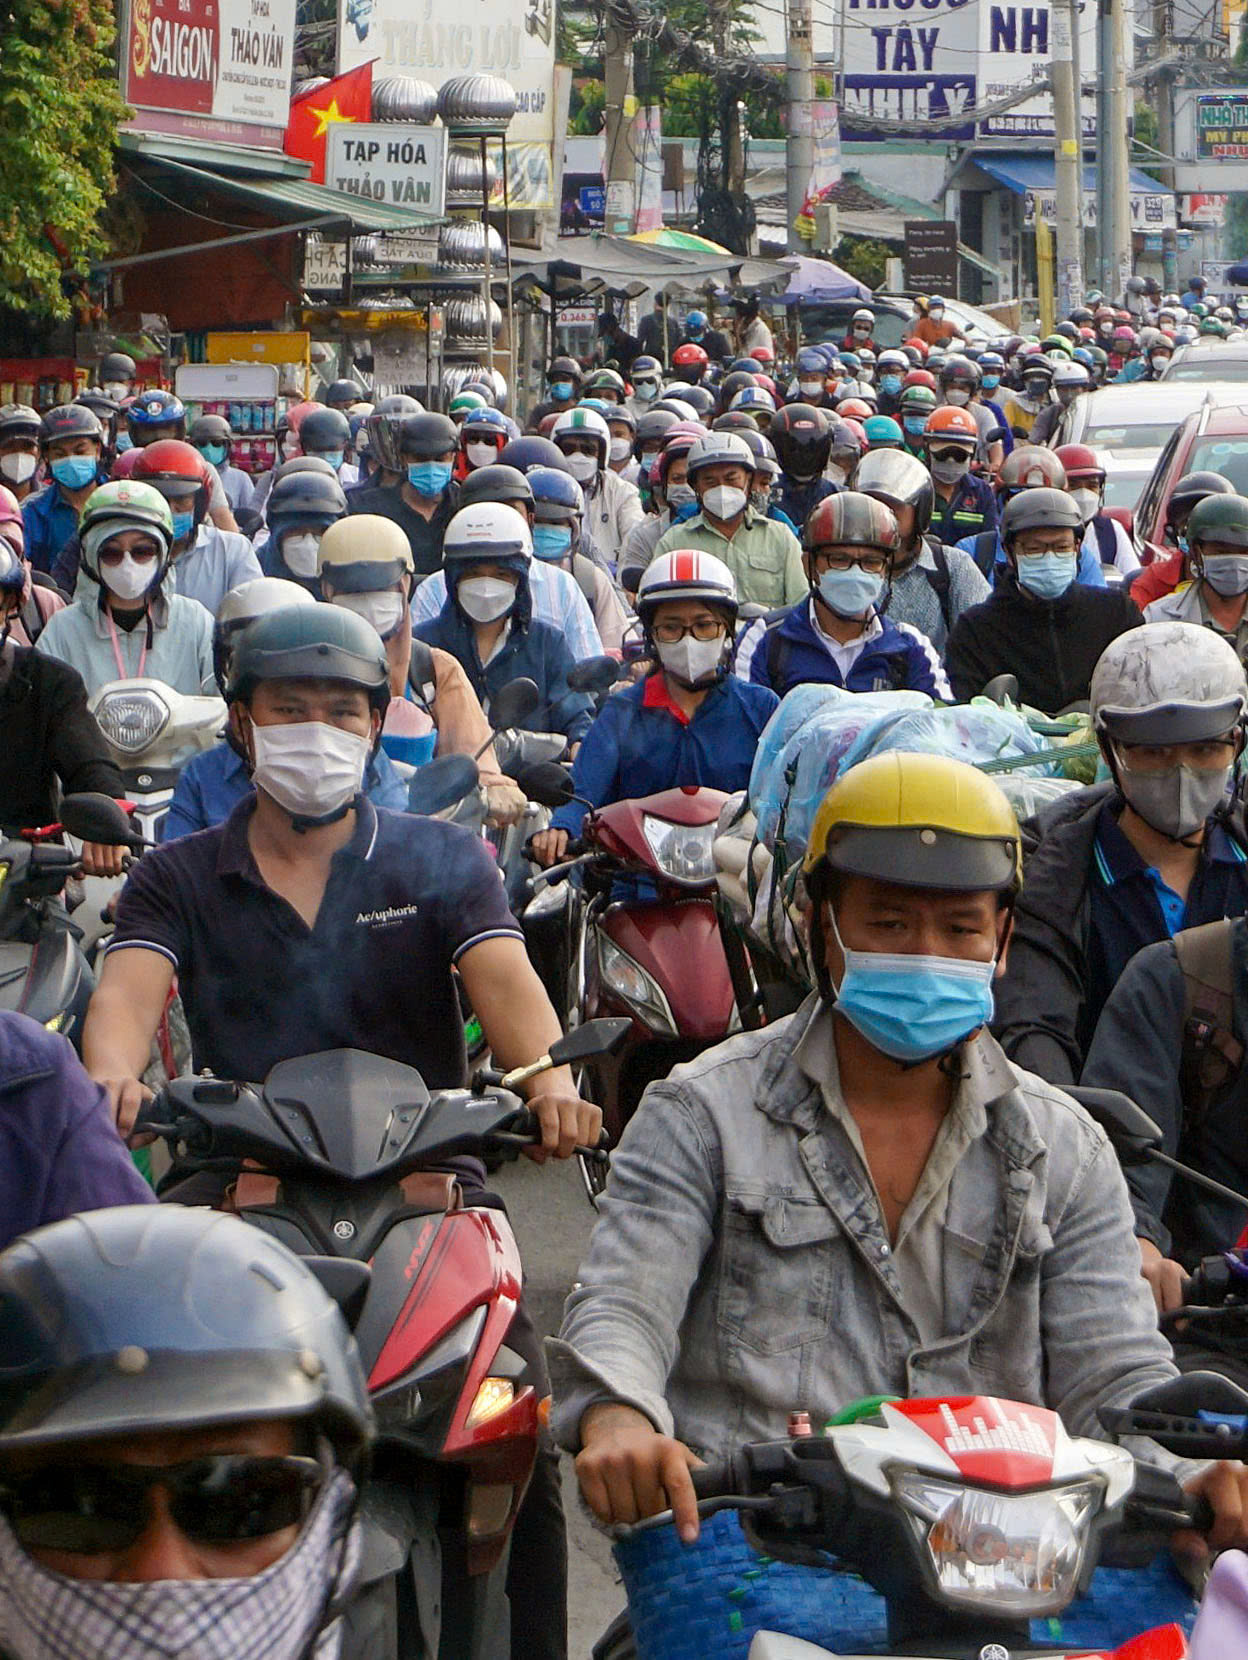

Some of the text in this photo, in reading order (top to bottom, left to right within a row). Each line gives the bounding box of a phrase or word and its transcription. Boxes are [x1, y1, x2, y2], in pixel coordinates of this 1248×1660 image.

[150, 16, 213, 81] SAIGON
[871, 20, 940, 71] TÂY
[990, 6, 1049, 54] NH
[1202, 101, 1233, 127] NHÀ
[343, 138, 427, 167] TẠP HÓA
[337, 171, 431, 203] THẢO VÂN
